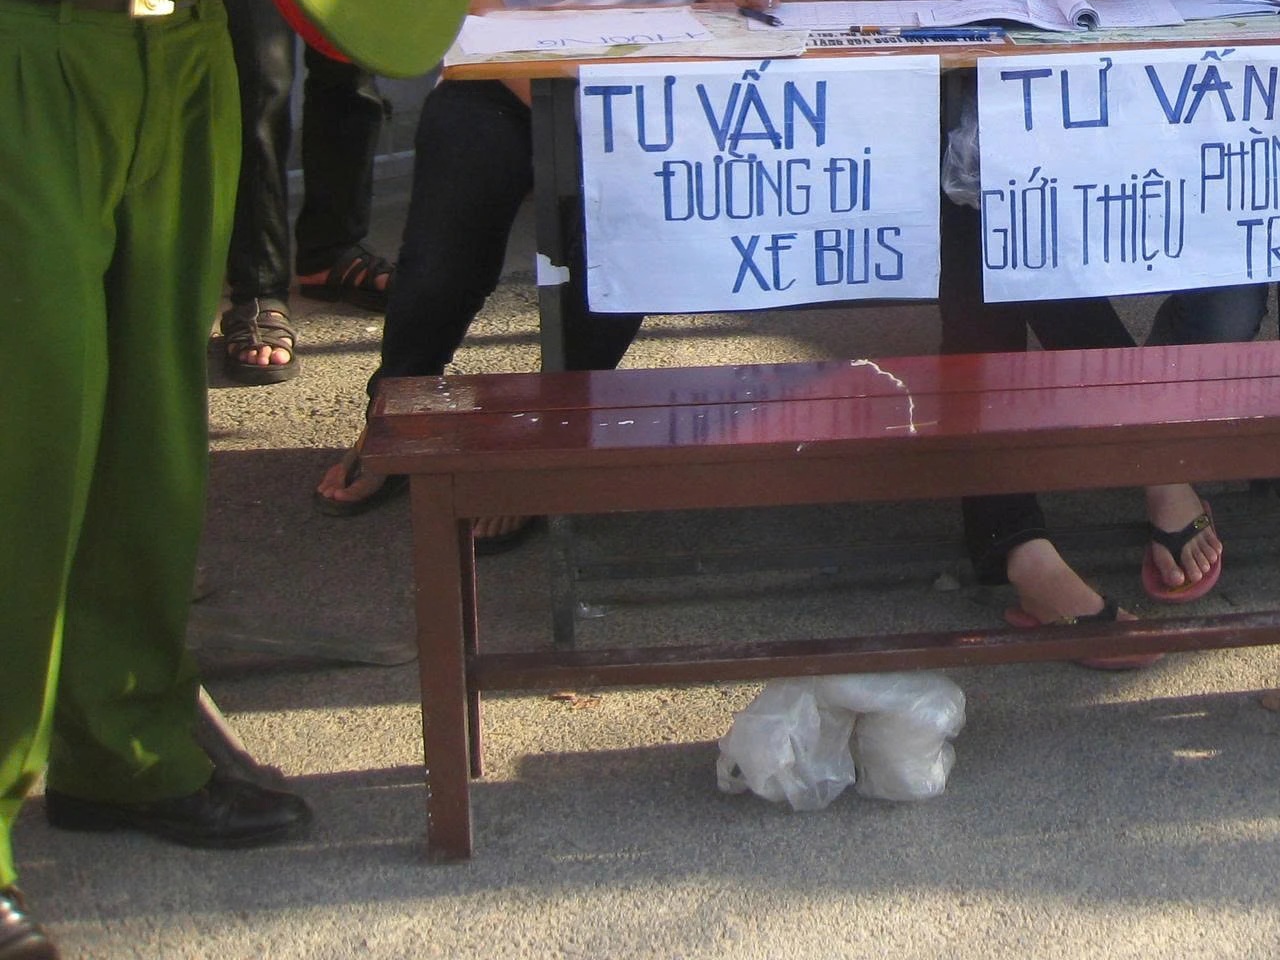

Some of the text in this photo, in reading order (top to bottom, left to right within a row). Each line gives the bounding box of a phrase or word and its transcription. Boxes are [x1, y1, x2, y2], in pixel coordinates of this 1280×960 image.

[584, 60, 827, 153] TƯ VẤN
[1145, 48, 1278, 124] VẤN
[654, 150, 811, 221] ĐƯỜNG
[815, 226, 904, 285] BUS
